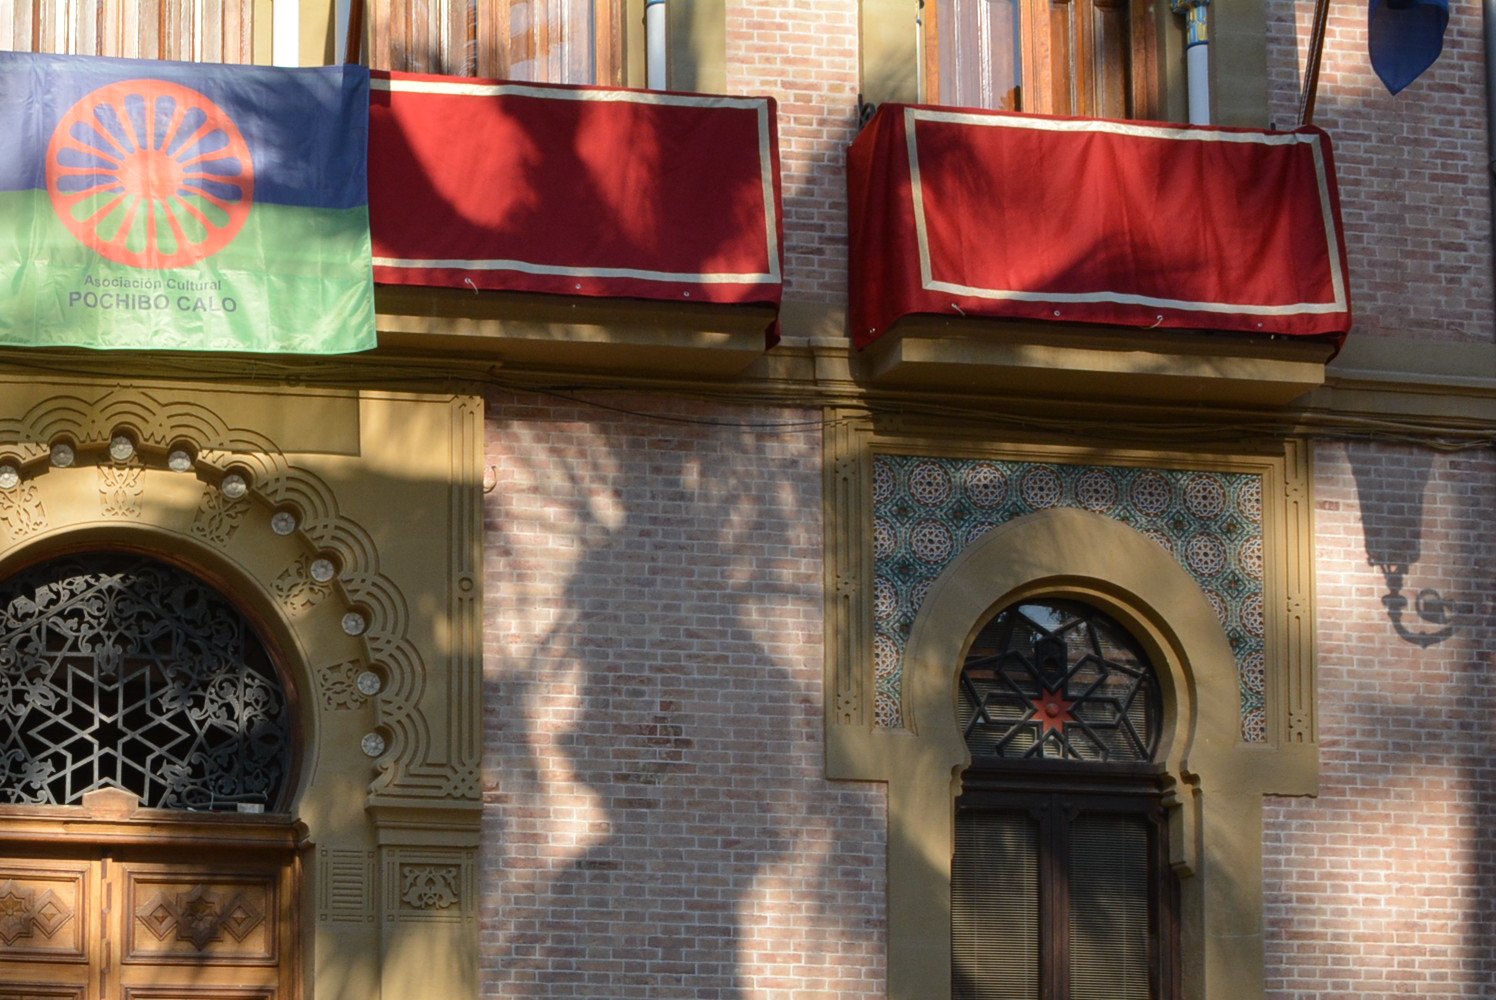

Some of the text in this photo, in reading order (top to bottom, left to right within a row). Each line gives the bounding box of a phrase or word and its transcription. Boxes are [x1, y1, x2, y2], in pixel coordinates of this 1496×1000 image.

[84, 275, 222, 291] Asociación Cultural
[68, 291, 238, 313] POCHIBO CALO
